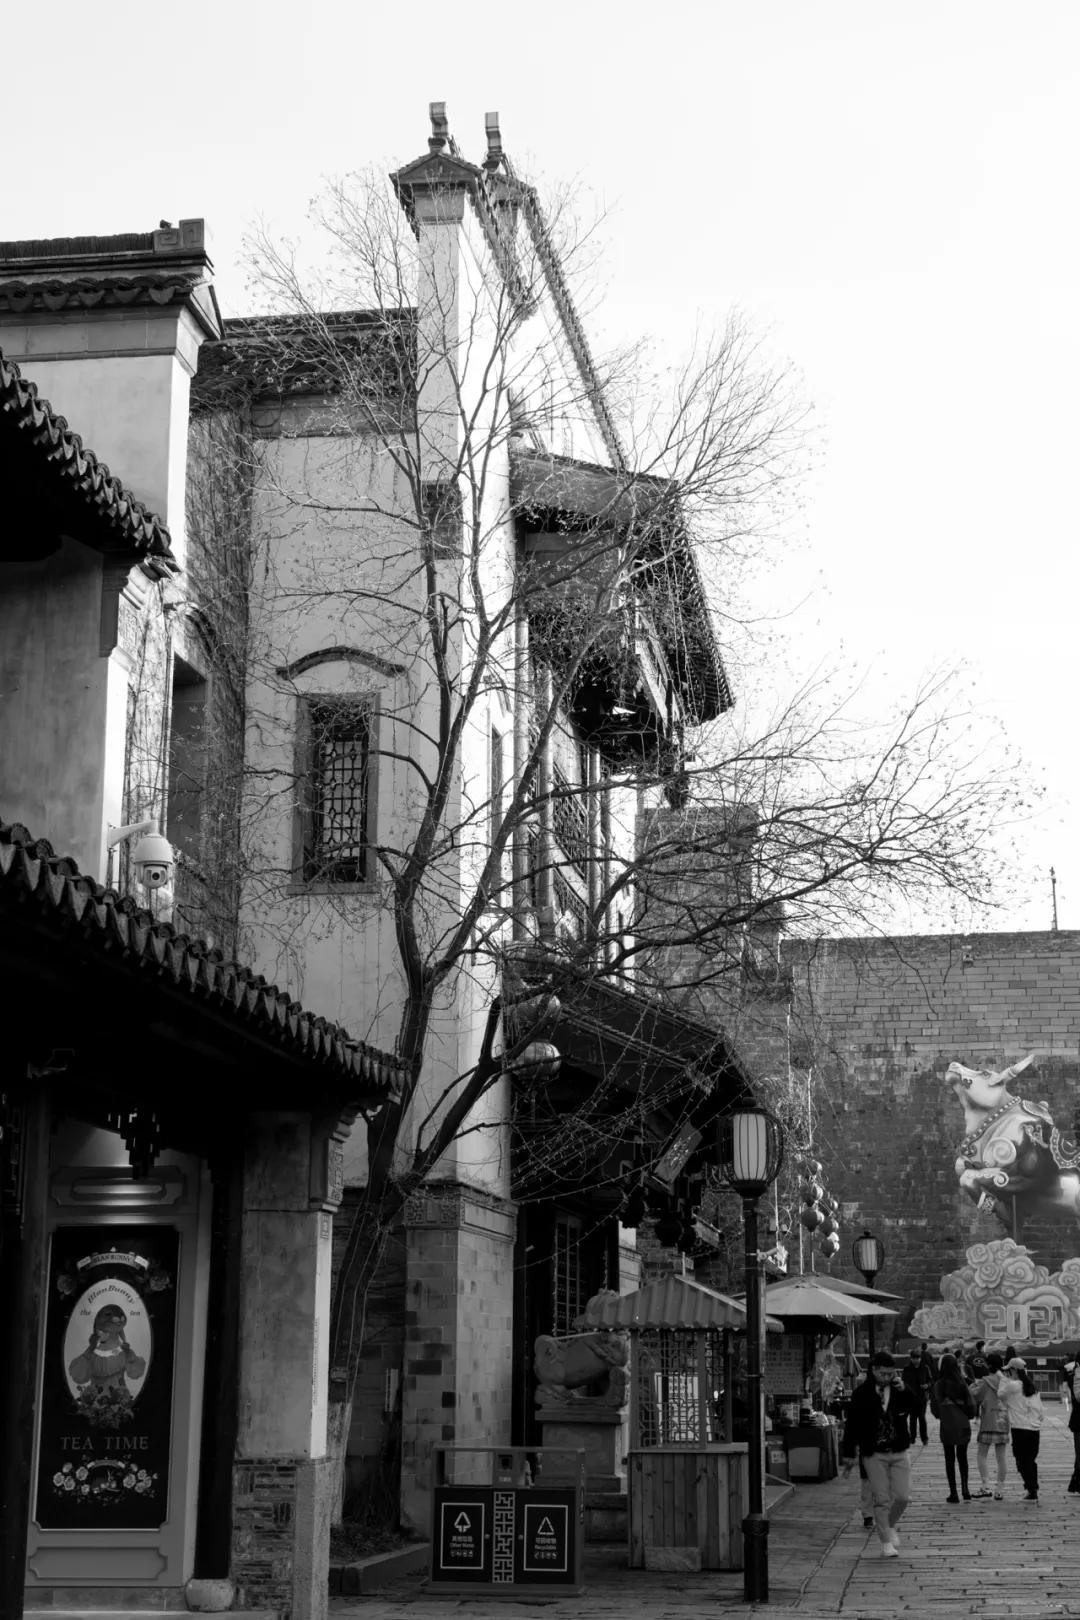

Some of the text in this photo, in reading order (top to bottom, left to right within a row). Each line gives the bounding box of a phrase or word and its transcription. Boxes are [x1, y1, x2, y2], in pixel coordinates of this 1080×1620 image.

[984, 1304, 1064, 1340] 2021
[60, 1436, 149, 1450] TEA TIME
